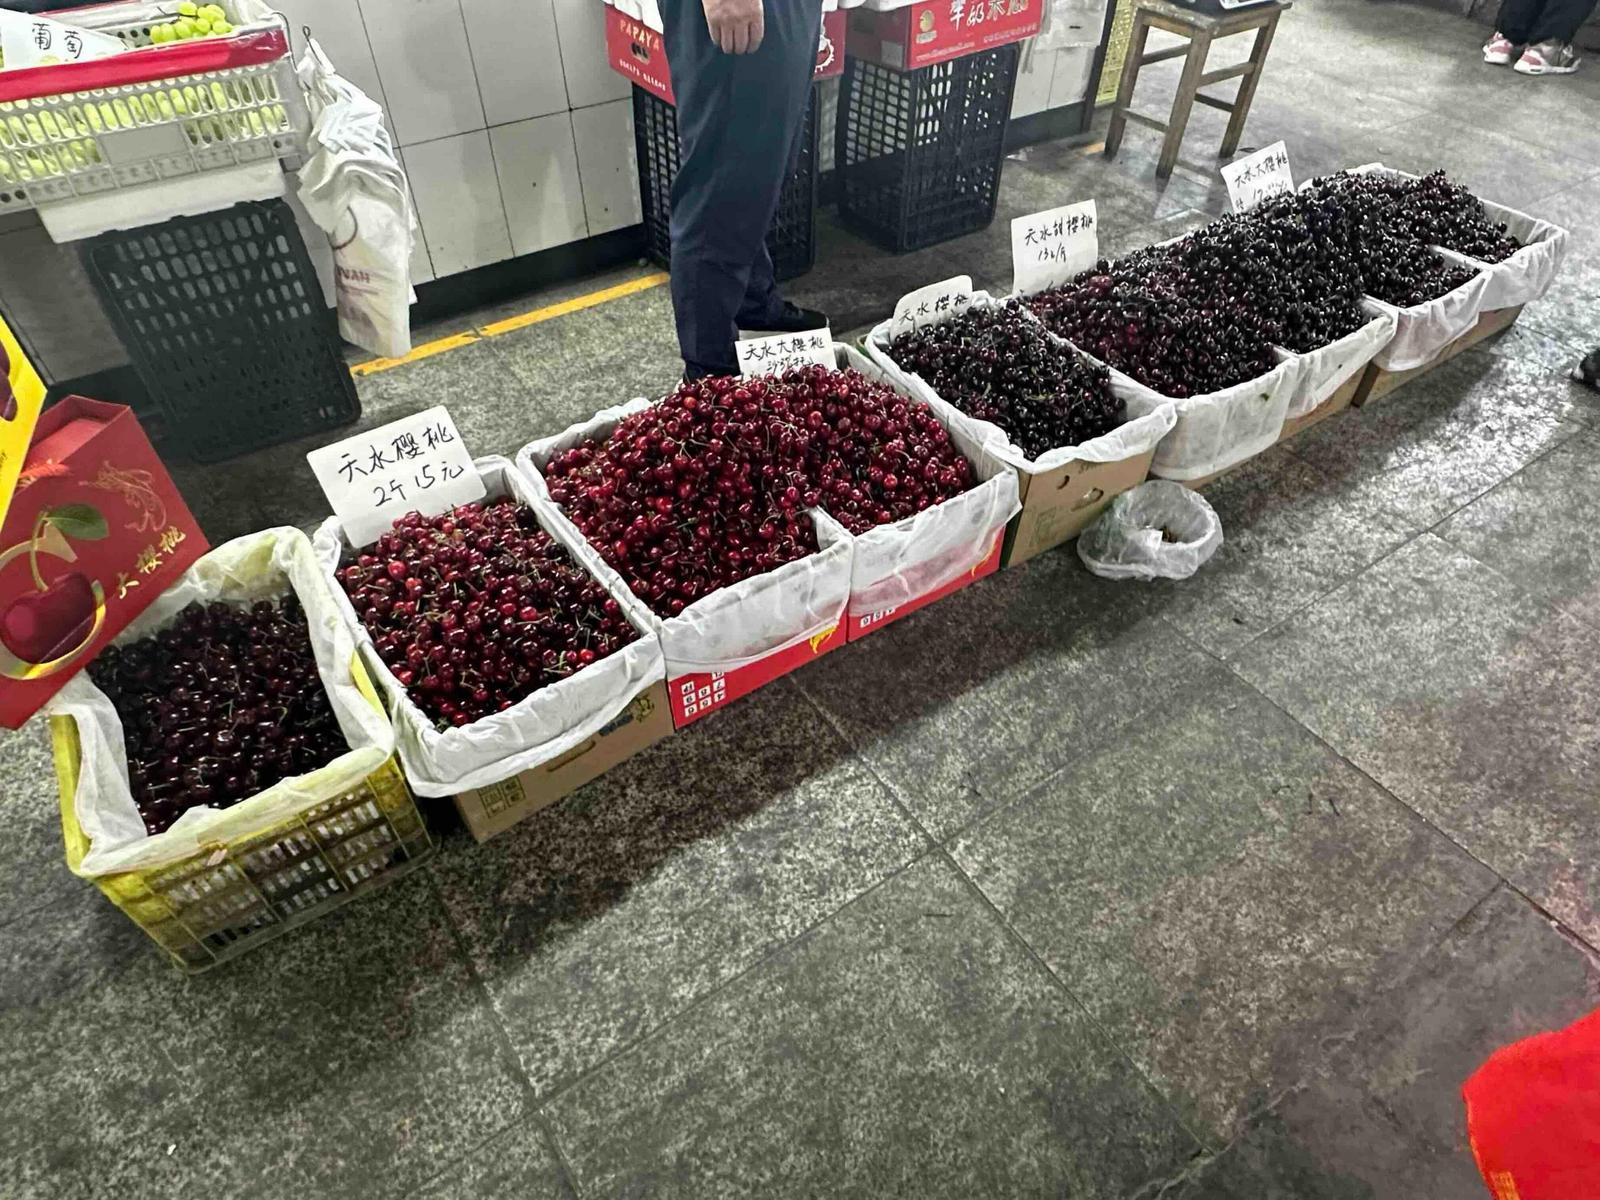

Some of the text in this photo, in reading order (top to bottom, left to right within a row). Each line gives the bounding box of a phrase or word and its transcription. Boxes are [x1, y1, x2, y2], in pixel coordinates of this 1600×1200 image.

[32, 22, 83, 59] 葡萄
[338, 422, 455, 483] 天水樱桃
